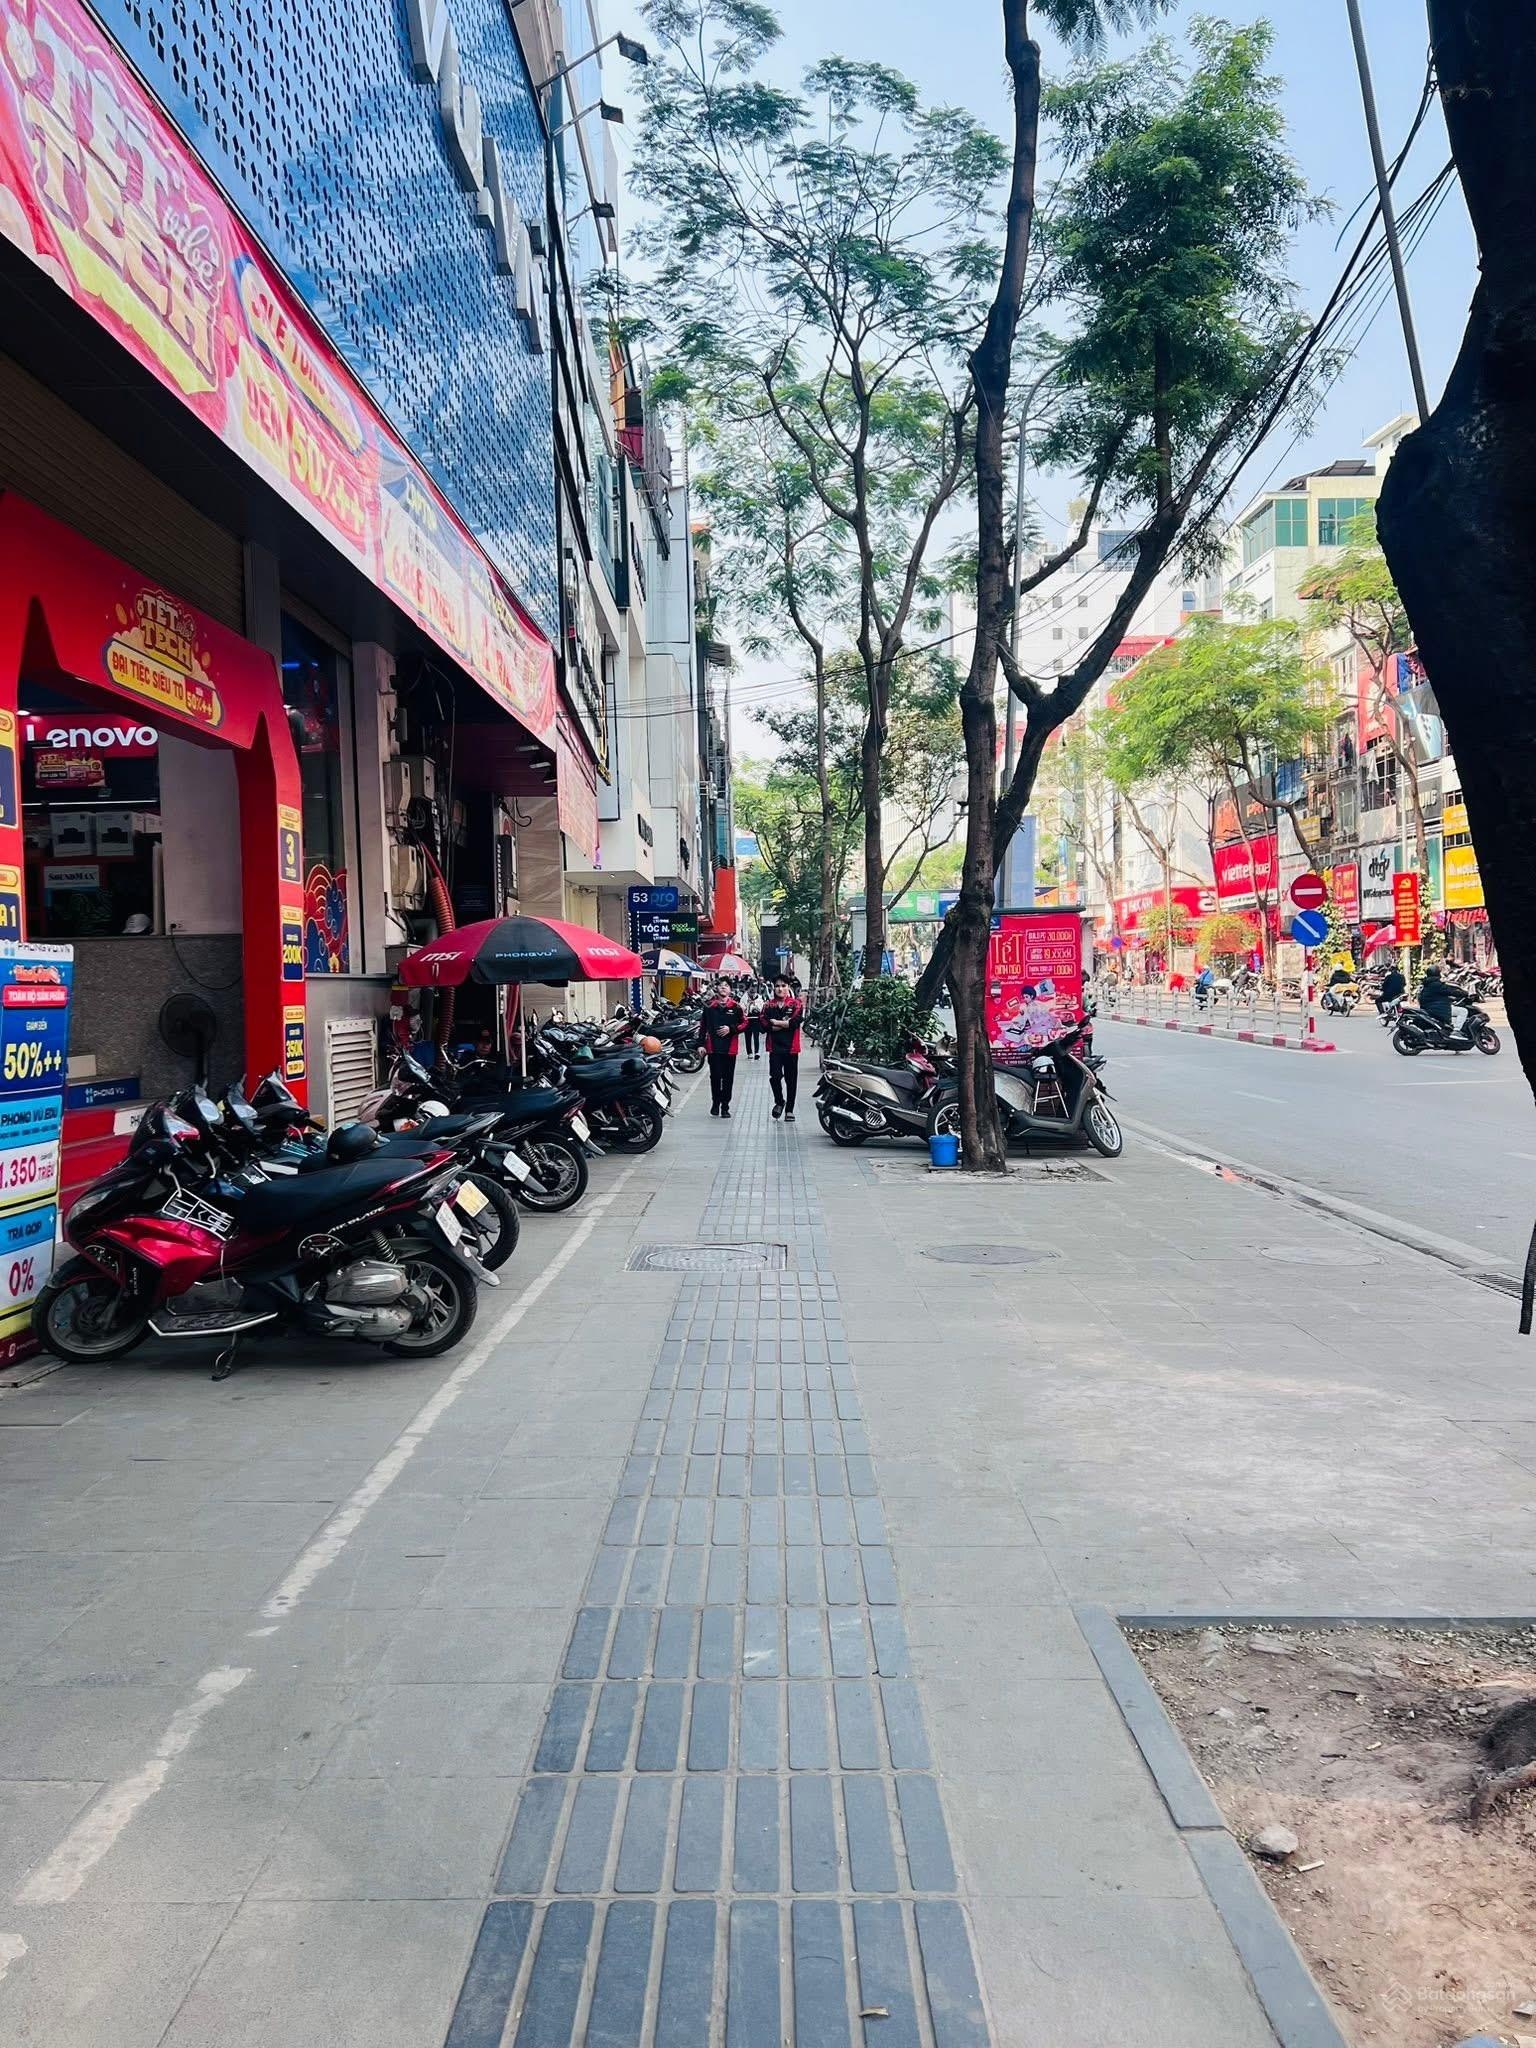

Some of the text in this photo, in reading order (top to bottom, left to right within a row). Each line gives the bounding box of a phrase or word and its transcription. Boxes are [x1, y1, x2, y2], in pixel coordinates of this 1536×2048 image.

[24, 86, 211, 375] TECH
[142, 594, 180, 627] TẾT
[141, 617, 192, 671] TECH
[112, 652, 128, 677] ĐẠI
[130, 660, 150, 686] TIỆC
[152, 671, 171, 694] SIÊU
[172, 680, 183, 700] TO
[26, 725, 158, 747] Lenovo
[286, 833, 295, 865] 3
[632, 893, 675, 904] 53 pro
[283, 944, 303, 964] 200K
[420, 952, 464, 962] msi
[587, 947, 619, 956] msi
[4, 1041, 61, 1079] 50%++
[1, 1111, 31, 1126] PHONG
[9, 1256, 34, 1296] 0%
